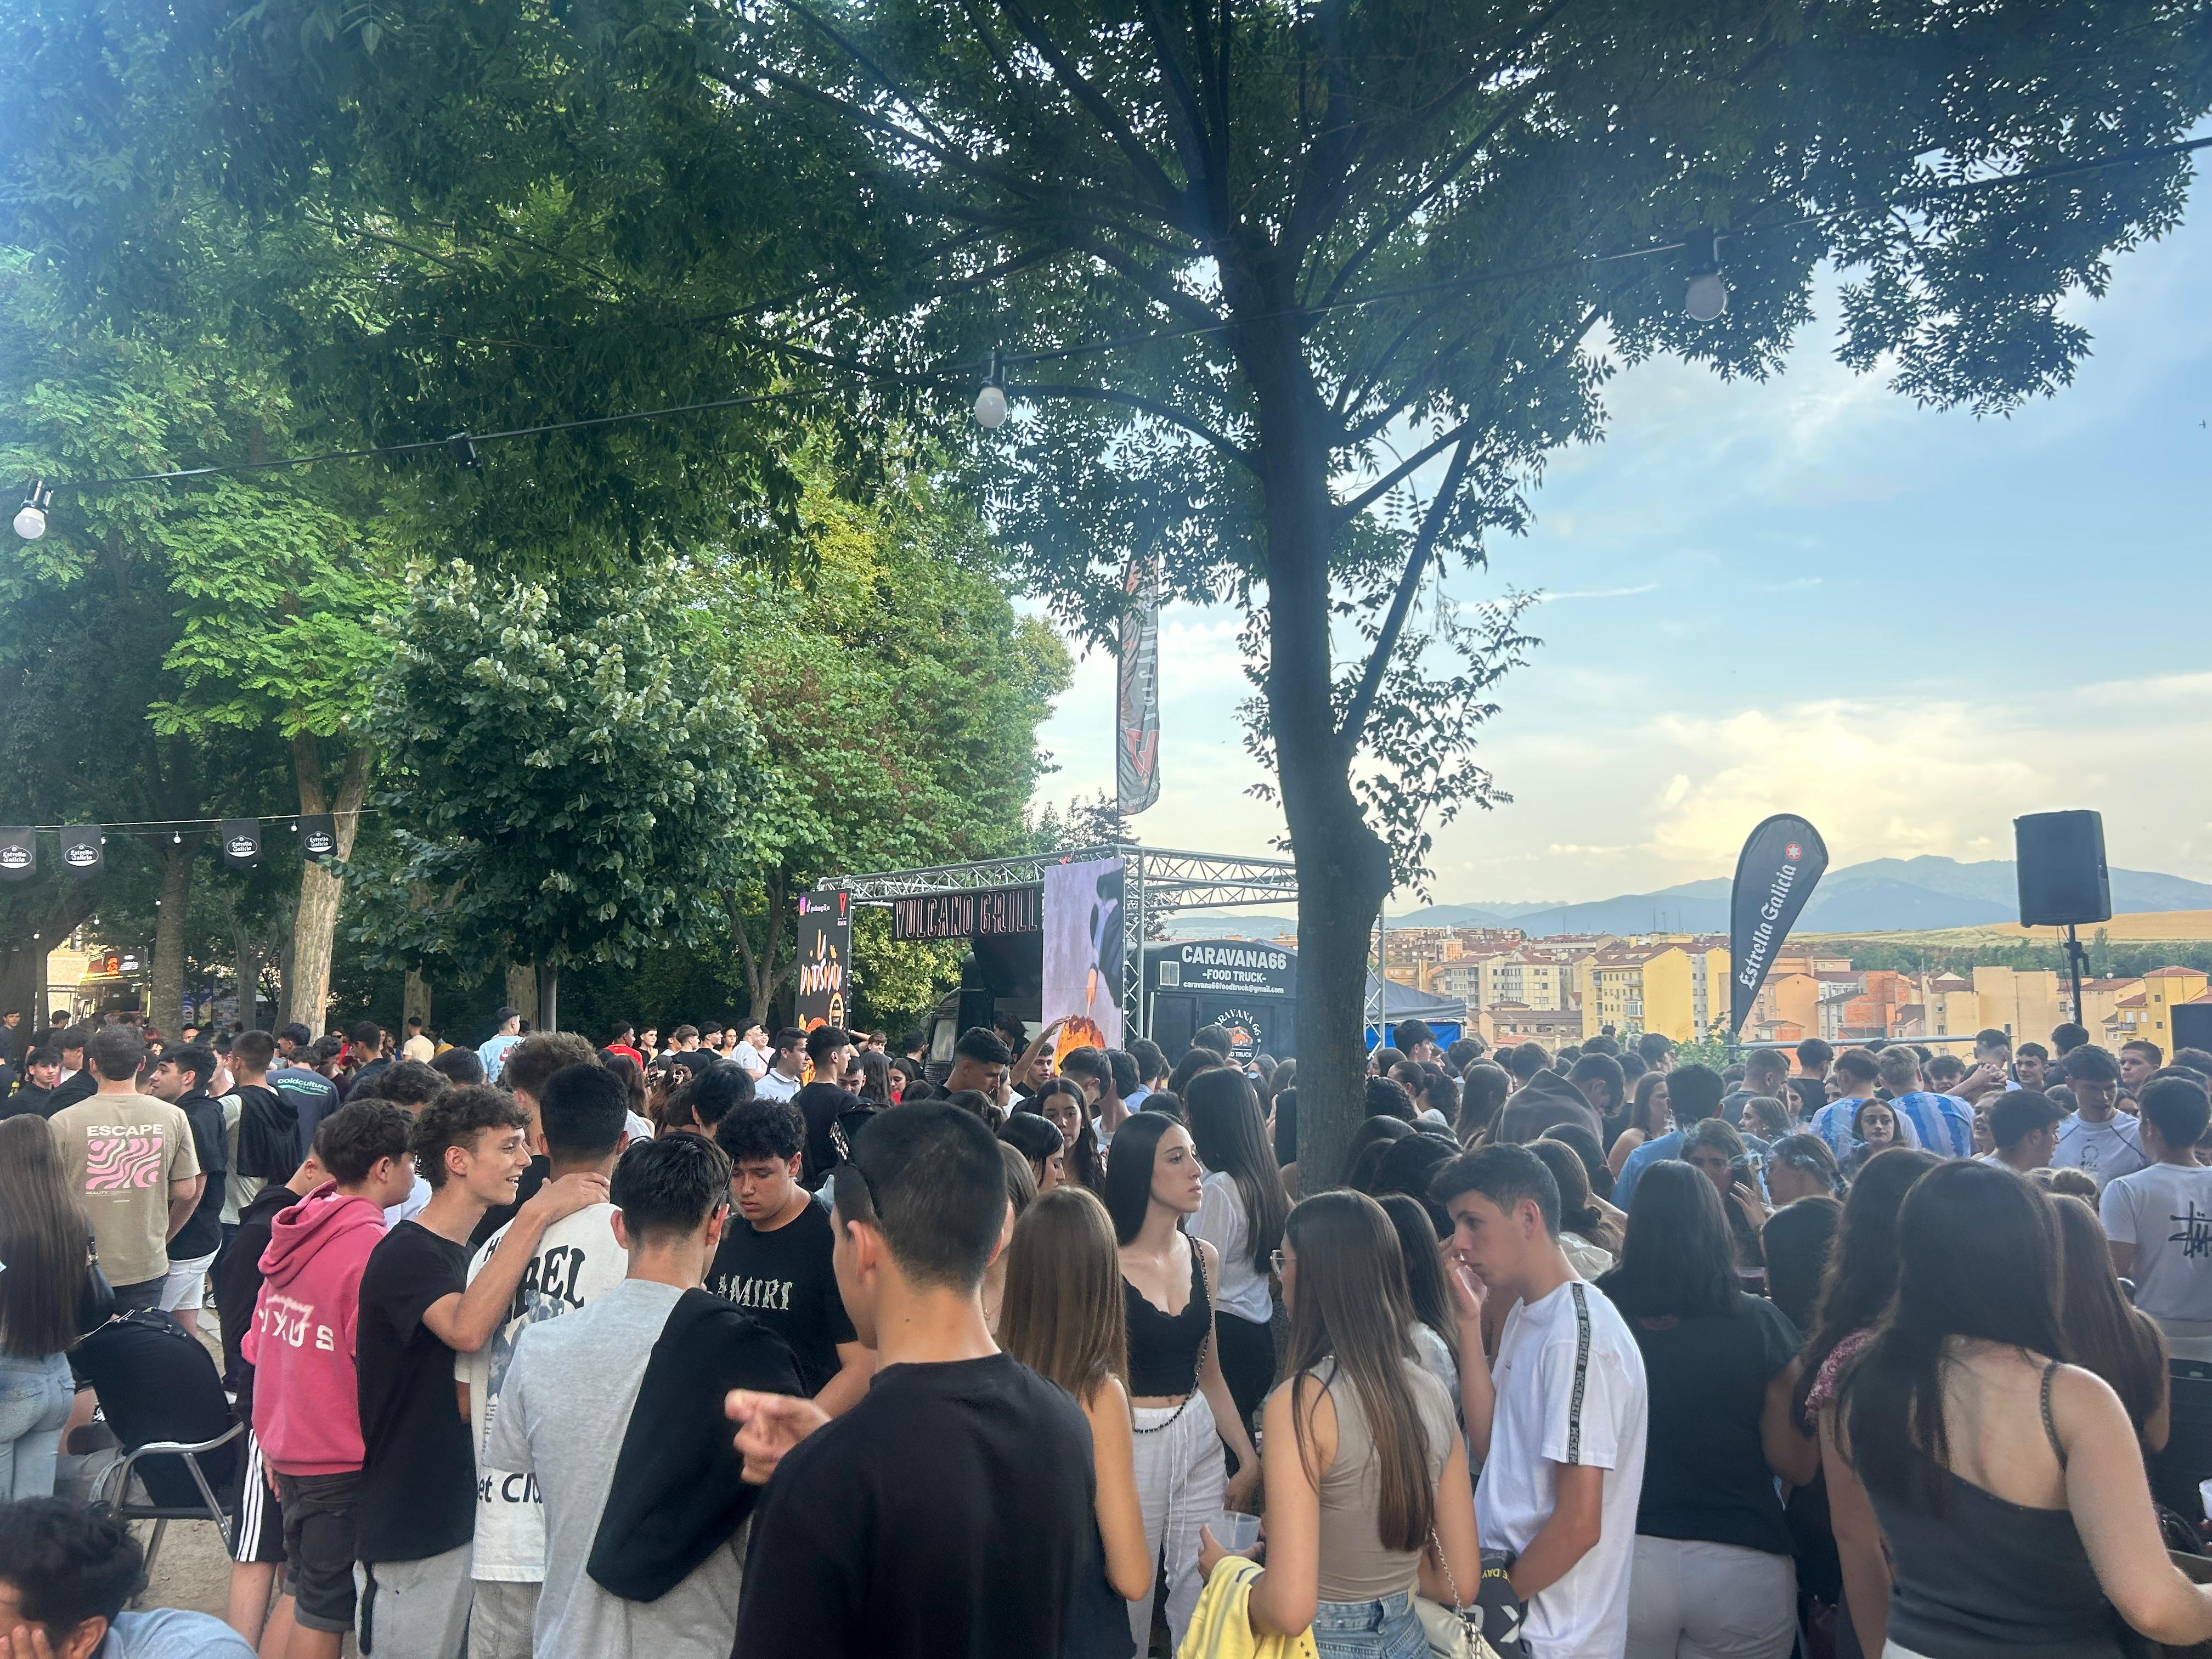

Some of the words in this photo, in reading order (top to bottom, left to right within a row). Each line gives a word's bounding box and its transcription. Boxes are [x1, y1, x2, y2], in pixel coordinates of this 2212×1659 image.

[895, 895, 974, 939] VULCANO
[980, 889, 1037, 934] GRILL
[1739, 922, 1773, 990] Estrella
[1760, 864, 1796, 921] Galicia
[1182, 945, 1286, 970] CARAVANA66
[1183, 981, 1284, 994] caravana66foodtruck@gmail.com
[87, 1124, 163, 1137] ESCAPE
[716, 1272, 793, 1311] AMIRI
